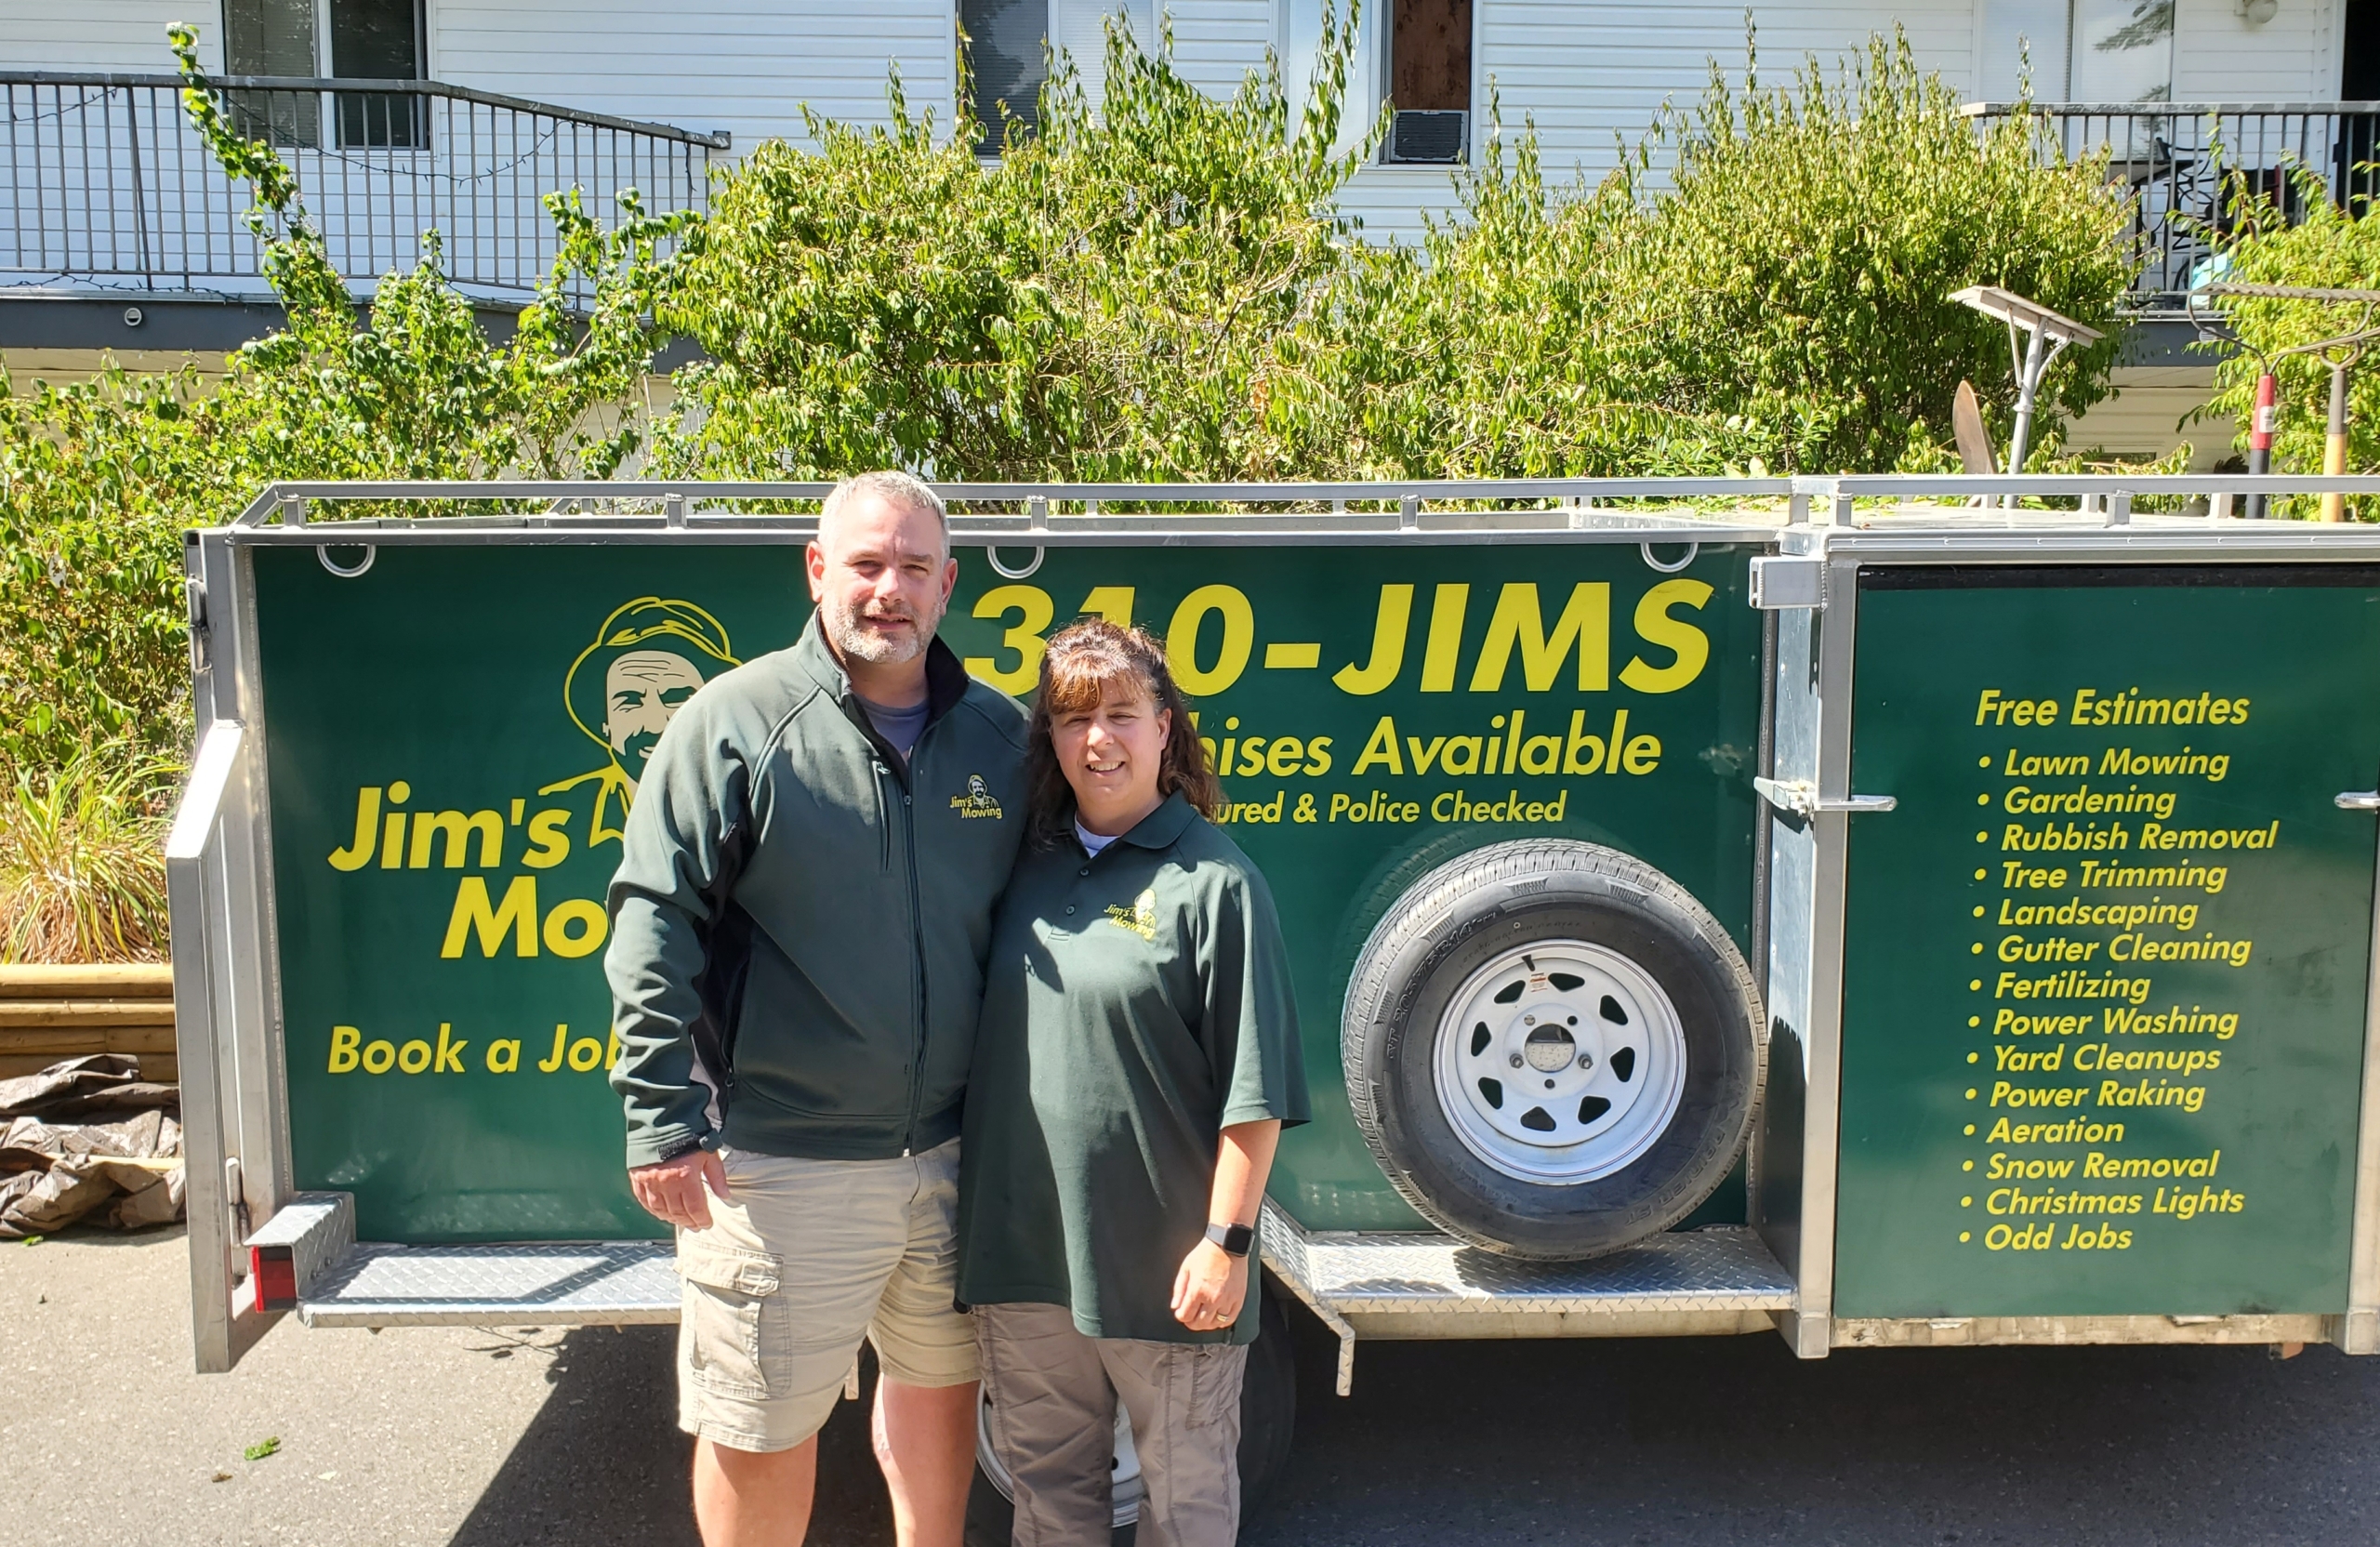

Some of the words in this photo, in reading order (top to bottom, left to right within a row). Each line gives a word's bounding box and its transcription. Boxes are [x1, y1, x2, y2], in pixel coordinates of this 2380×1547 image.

[1976, 689, 2058, 726] Free
[2070, 686, 2250, 726] Estimates
[1188, 711, 1334, 777] hises
[1352, 709, 1661, 775] Available
[2004, 748, 2090, 776] Lawn
[2098, 746, 2230, 782] Mowing
[949, 795, 973, 809] Jim's
[961, 805, 1003, 820] Mowing
[1210, 790, 1285, 825] ured
[1292, 793, 1317, 824] &
[1329, 790, 1421, 823] Police
[1431, 789, 1567, 822] Checked
[2004, 784, 2176, 820] Gardening
[327, 779, 572, 872] Jim's
[2002, 821, 2129, 852] Rubbish
[2139, 820, 2280, 851] Removal
[2003, 861, 2068, 889] Tree
[2080, 858, 2228, 894] Trimming
[440, 875, 609, 959] Mo
[1104, 903, 1130, 918] Jim's
[1108, 916, 1156, 940] Mowing
[1998, 896, 2200, 932] Landscaping
[1998, 934, 2100, 963] Gutter
[2109, 932, 2253, 968] Cleaning
[1995, 970, 2151, 1005] Fertilizing
[1993, 1009, 2094, 1036] Power
[2104, 1005, 2240, 1040] Washing
[327, 1023, 468, 1075] Book
[485, 1038, 521, 1074] a
[1994, 1043, 2065, 1072] Yard
[2073, 1042, 2221, 1078] Cleanups
[1990, 1080, 2090, 1108] Power
[2096, 1078, 2206, 1113] Raking
[1987, 1115, 2125, 1144] Aeration
[1986, 1152, 2076, 1181] Snow
[2082, 1149, 2221, 1179] Removal
[1986, 1186, 2143, 1216] Christmas
[2151, 1184, 2245, 1221] Lights
[1984, 1222, 2056, 1251] Odd
[2060, 1222, 2133, 1250] Jobs
